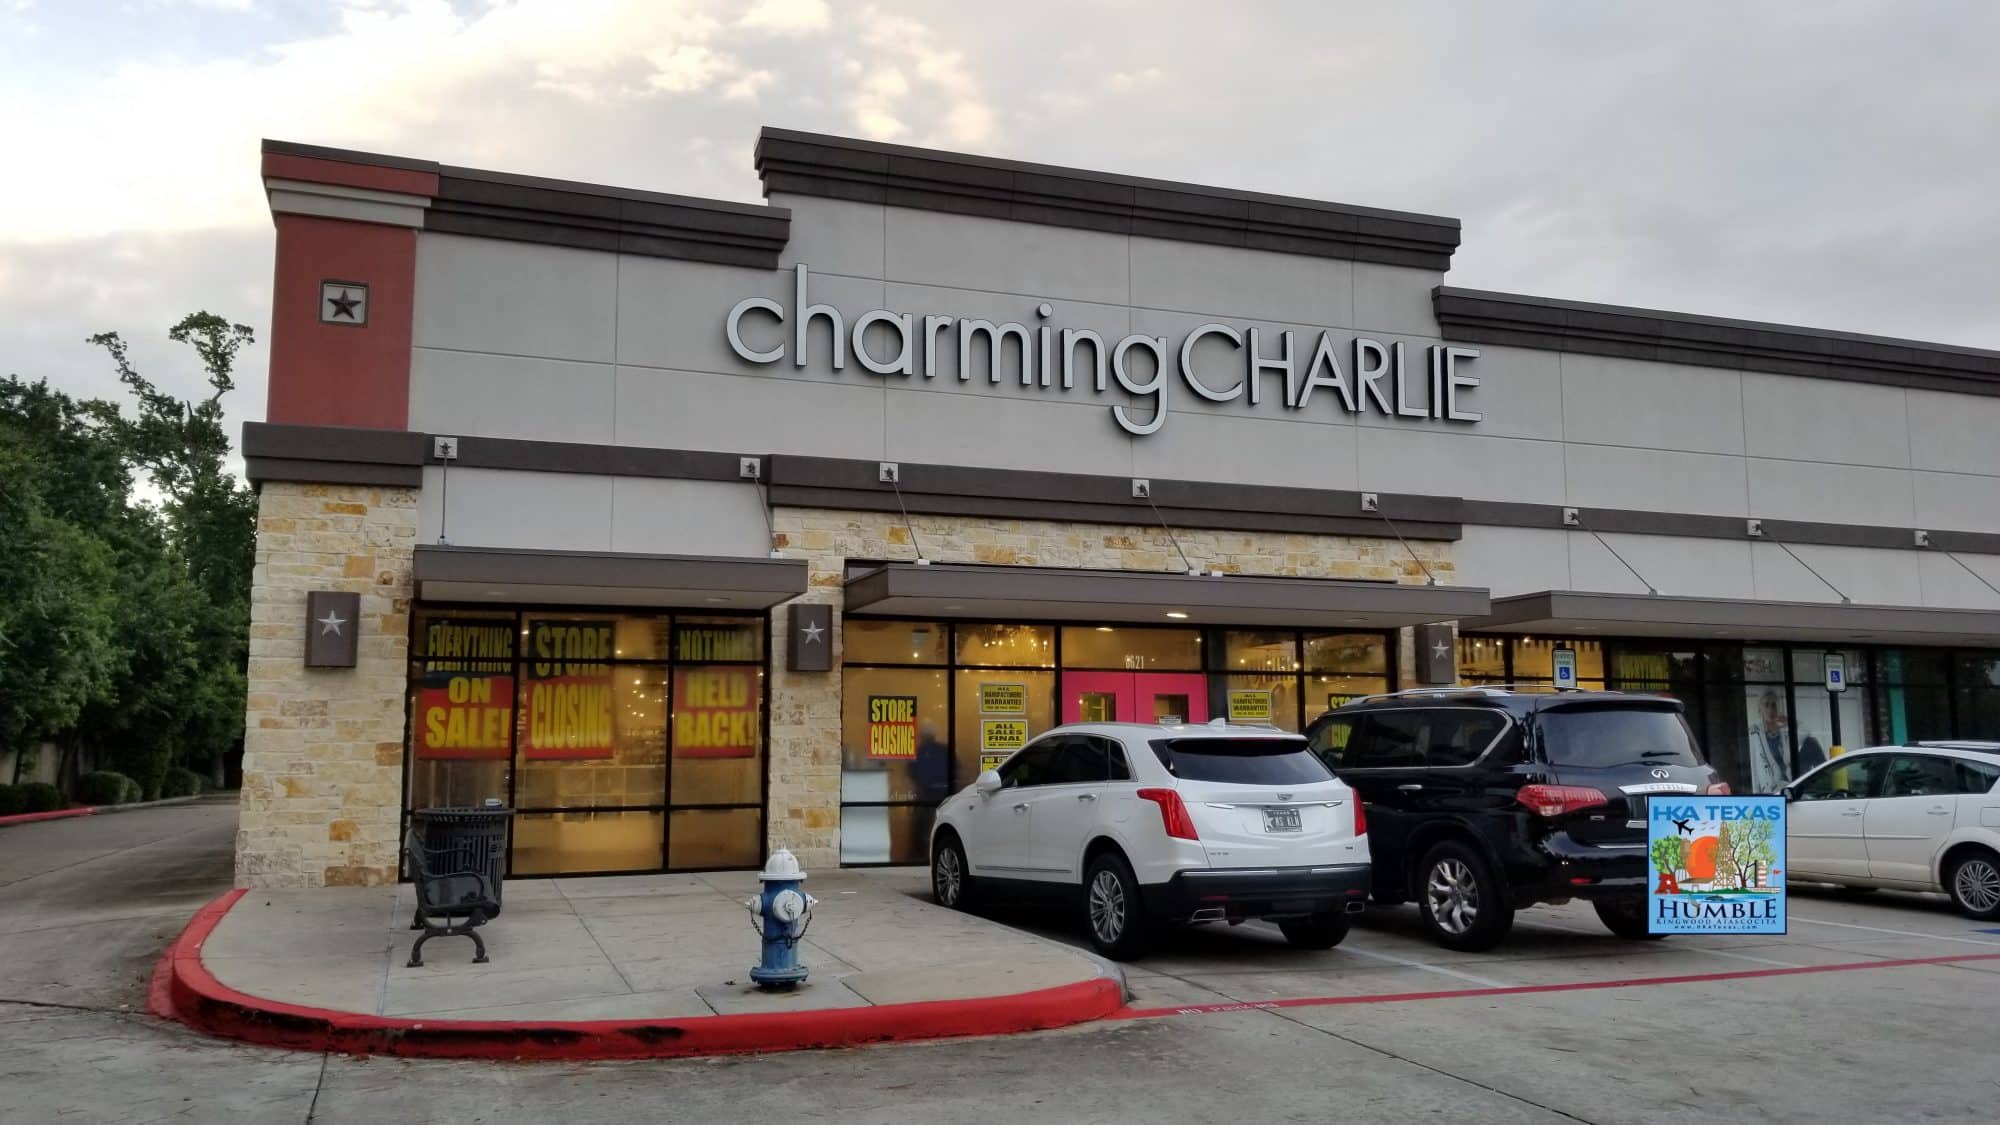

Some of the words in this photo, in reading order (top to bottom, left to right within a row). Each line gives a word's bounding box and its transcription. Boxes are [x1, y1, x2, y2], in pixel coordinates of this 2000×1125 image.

[428, 624, 512, 672] EVERYTHING
[535, 625, 611, 676] STORE
[448, 676, 492, 704] ON
[685, 671, 748, 707] HELD
[425, 706, 511, 748] SALE!
[531, 682, 611, 749] CLOSING
[871, 698, 914, 722] STORE
[677, 711, 755, 748] BACK!
[870, 724, 915, 756] CLOSING
